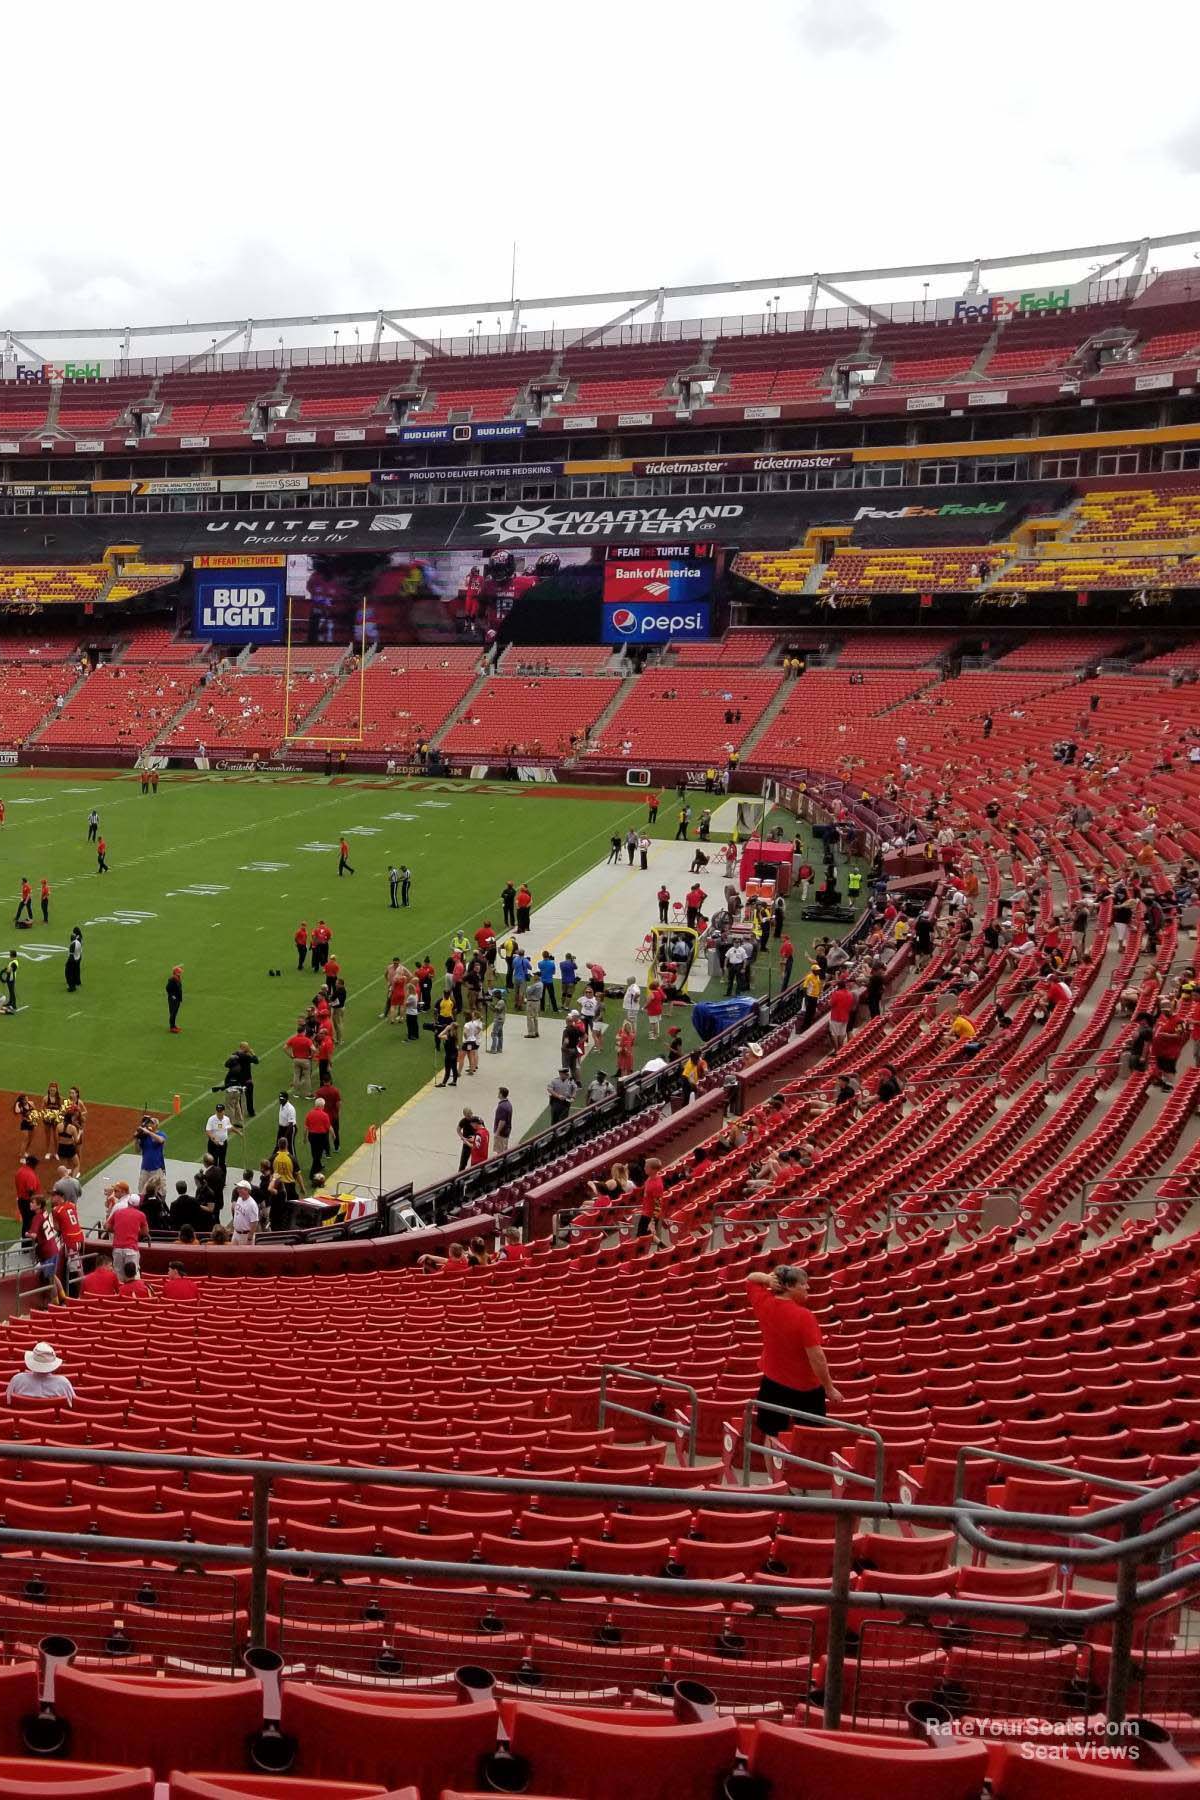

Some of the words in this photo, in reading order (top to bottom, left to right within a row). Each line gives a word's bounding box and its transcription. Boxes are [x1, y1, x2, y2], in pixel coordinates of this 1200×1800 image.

[954, 289, 1070, 320] FedExField
[17, 363, 100, 380] FedExField
[404, 431, 421, 440] BUD
[422, 430, 448, 439] LIGHT
[477, 428, 495, 436] BUD
[496, 426, 522, 435] LIGHT
[645, 461, 724, 474] ticketmaster
[753, 456, 836, 470] ticketmaster
[409, 471, 434, 480] PROUD
[435, 471, 446, 479] TO
[447, 470, 478, 478] DELIVER
[480, 469, 496, 477] FOR
[496, 468, 511, 476] THE
[563, 504, 744, 524] MARYLAND
[854, 501, 1007, 521] FedExField
[206, 519, 360, 532] UNITED
[558, 518, 705, 536] LOTTERY
[243, 534, 297, 545] Proud
[301, 534, 319, 543] to
[324, 533, 349, 543] fly
[615, 568, 643, 579] Bank
[643, 568, 655, 578] of
[655, 568, 701, 579] America
[213, 588, 266, 608] BUD
[203, 608, 275, 626] LIGHT
[641, 612, 702, 633] pepsi
[67, 1208, 78, 1226] 6
